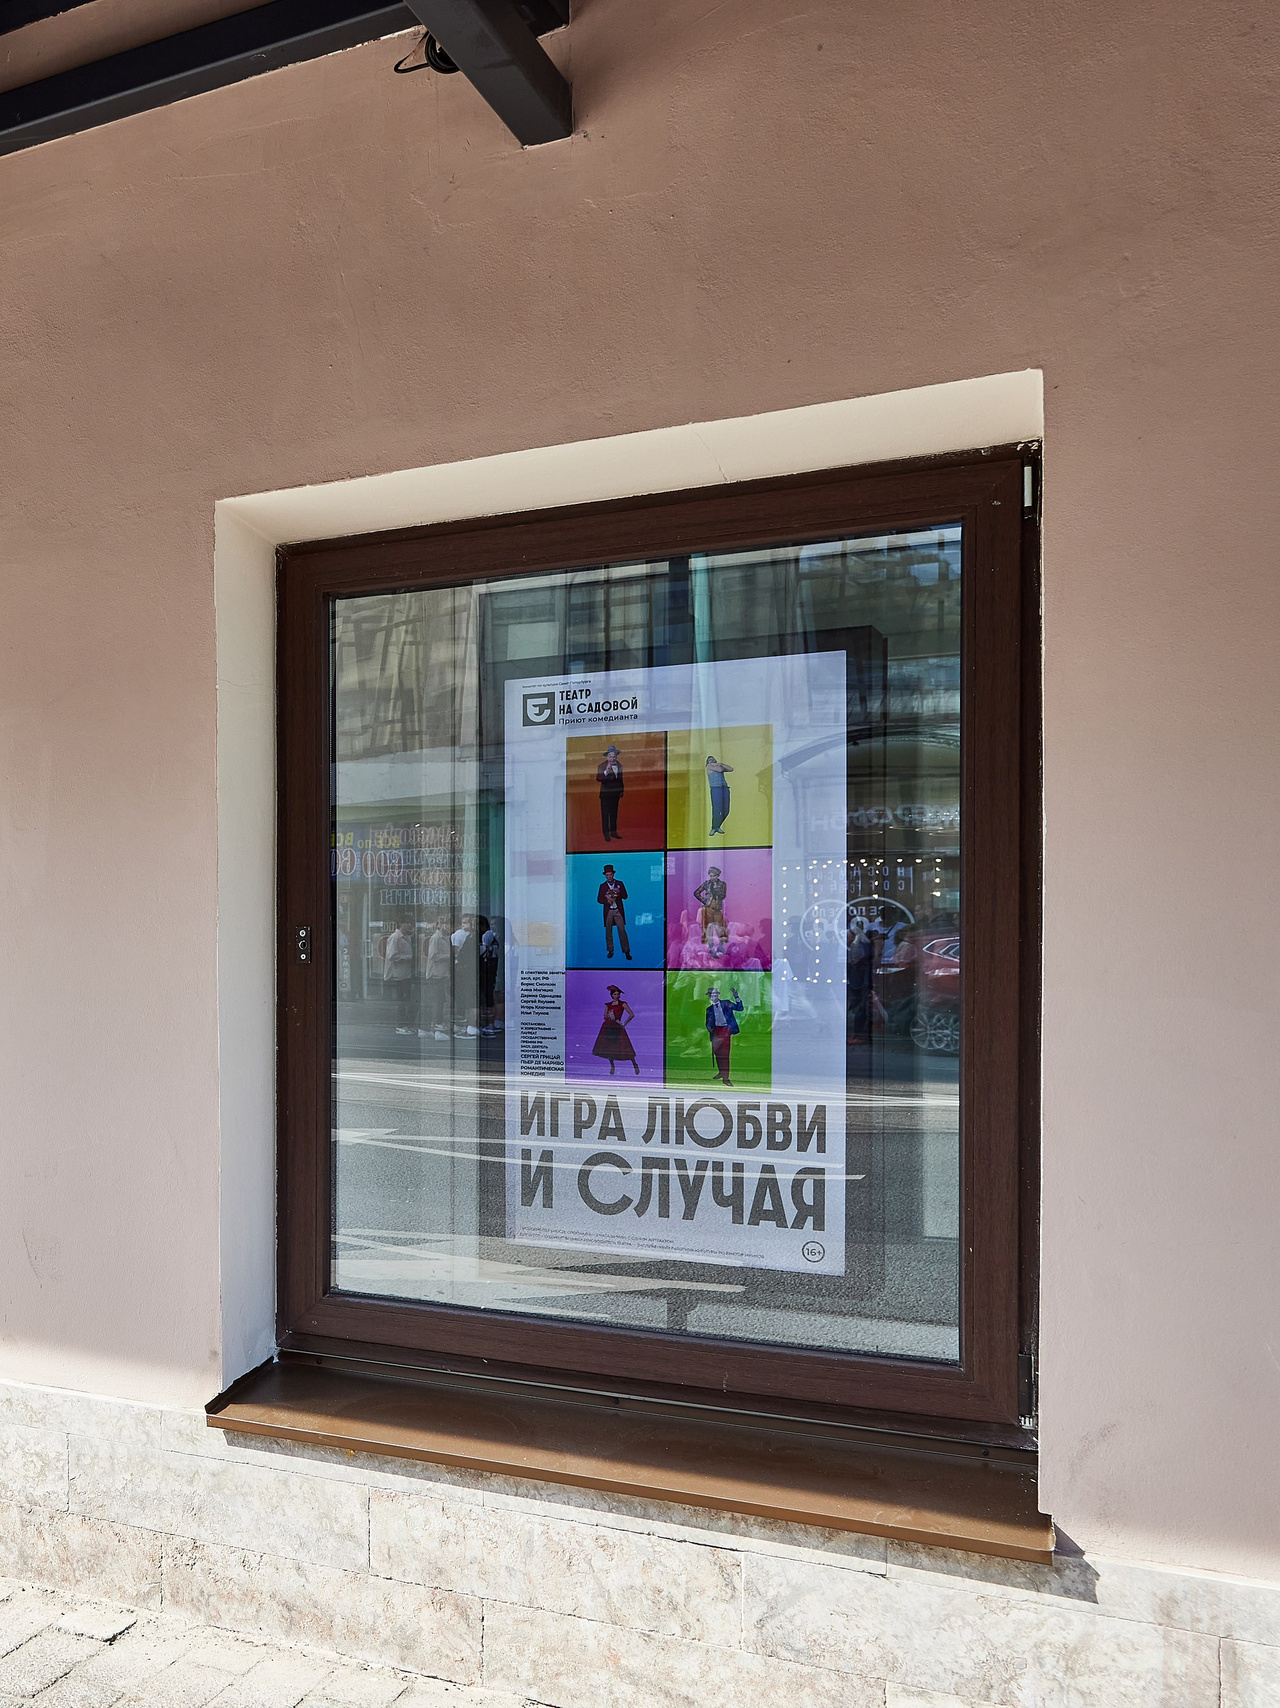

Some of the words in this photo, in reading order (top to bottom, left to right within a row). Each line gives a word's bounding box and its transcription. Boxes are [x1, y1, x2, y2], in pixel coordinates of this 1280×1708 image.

[559, 689, 591, 701] ТЕАТР
[559, 704, 573, 715] НА
[577, 697, 638, 713] САДОВОЙ
[559, 717, 586, 725] Приют
[588, 714, 638, 723] комедианта
[520, 1090, 627, 1142] ИГРА
[641, 1096, 827, 1154] ЛЮБВИ
[520, 1148, 554, 1209] И
[577, 1151, 826, 1232] СЛУЧАЯ
[806, 1248, 822, 1256] 16+
